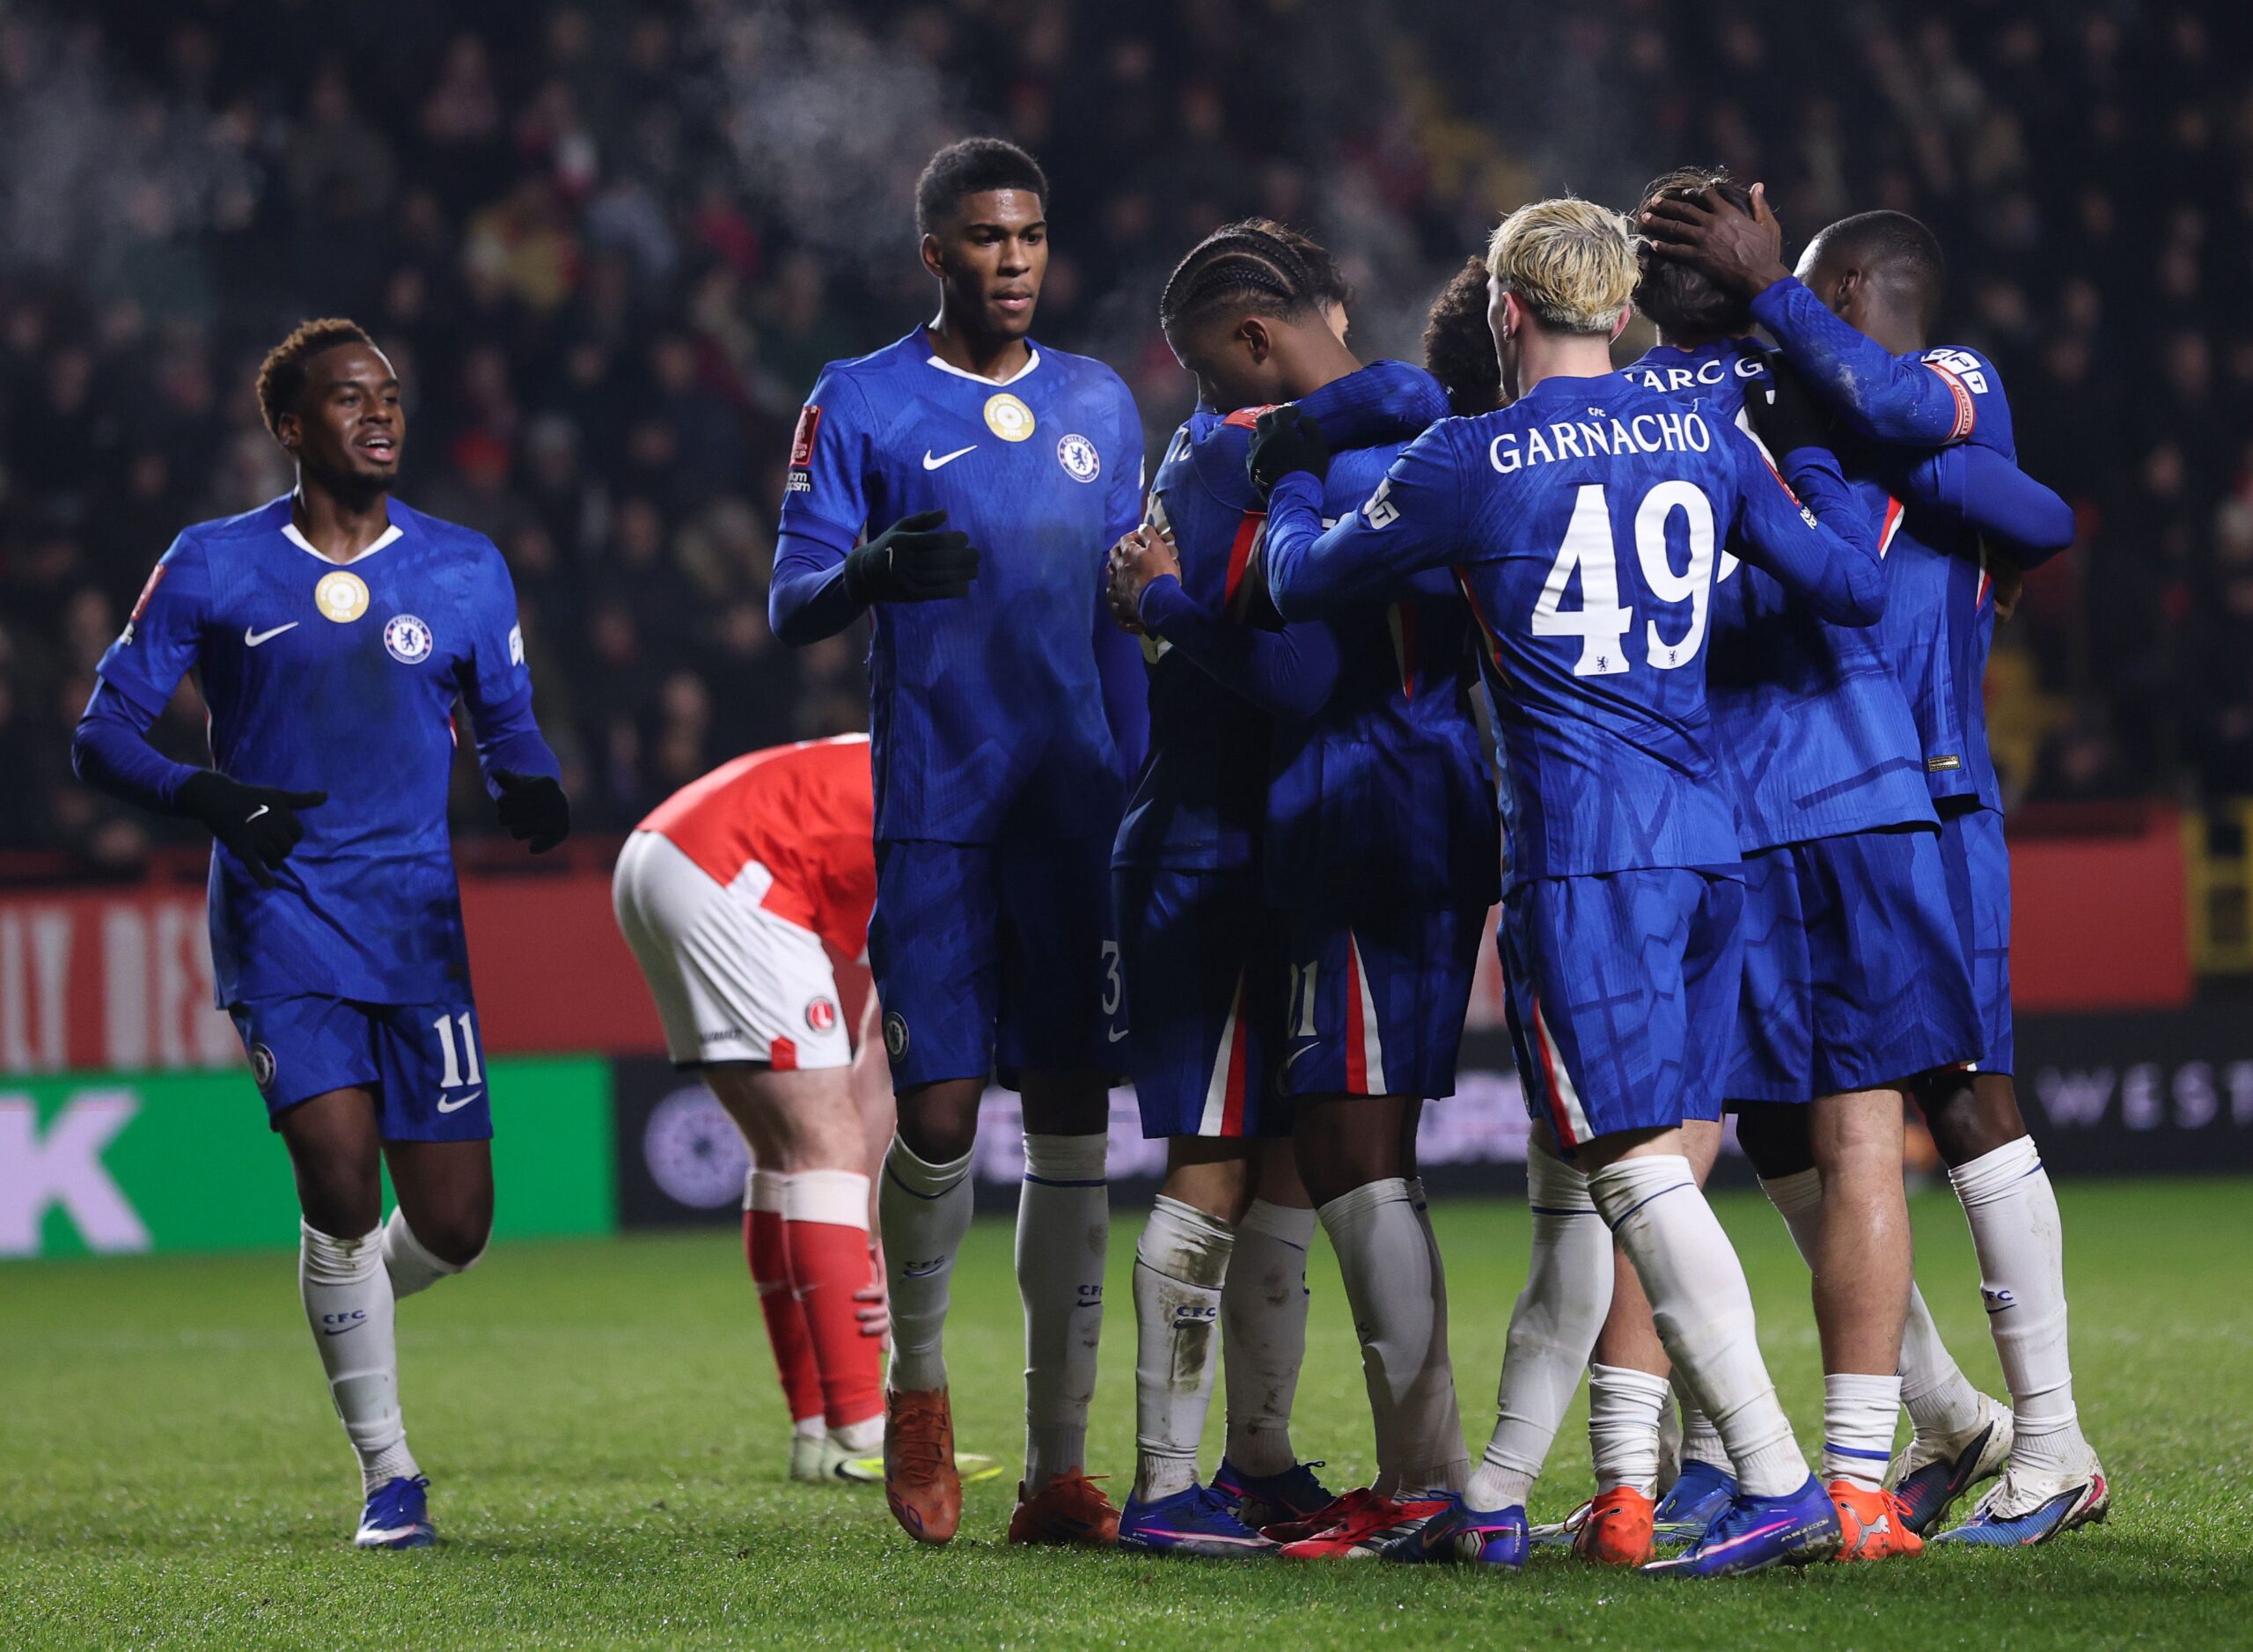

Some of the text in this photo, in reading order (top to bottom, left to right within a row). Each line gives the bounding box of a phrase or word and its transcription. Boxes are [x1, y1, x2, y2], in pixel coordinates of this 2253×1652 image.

[1625, 360, 1725, 393] ARC
[1588, 407, 1606, 418] CFC
[1489, 413, 1711, 474] GARNACHO
[1531, 481, 1714, 676] 49
[434, 1011, 482, 1088] 11
[323, 1310, 367, 1325] CFC
[1177, 1306, 1216, 1318] CFC
